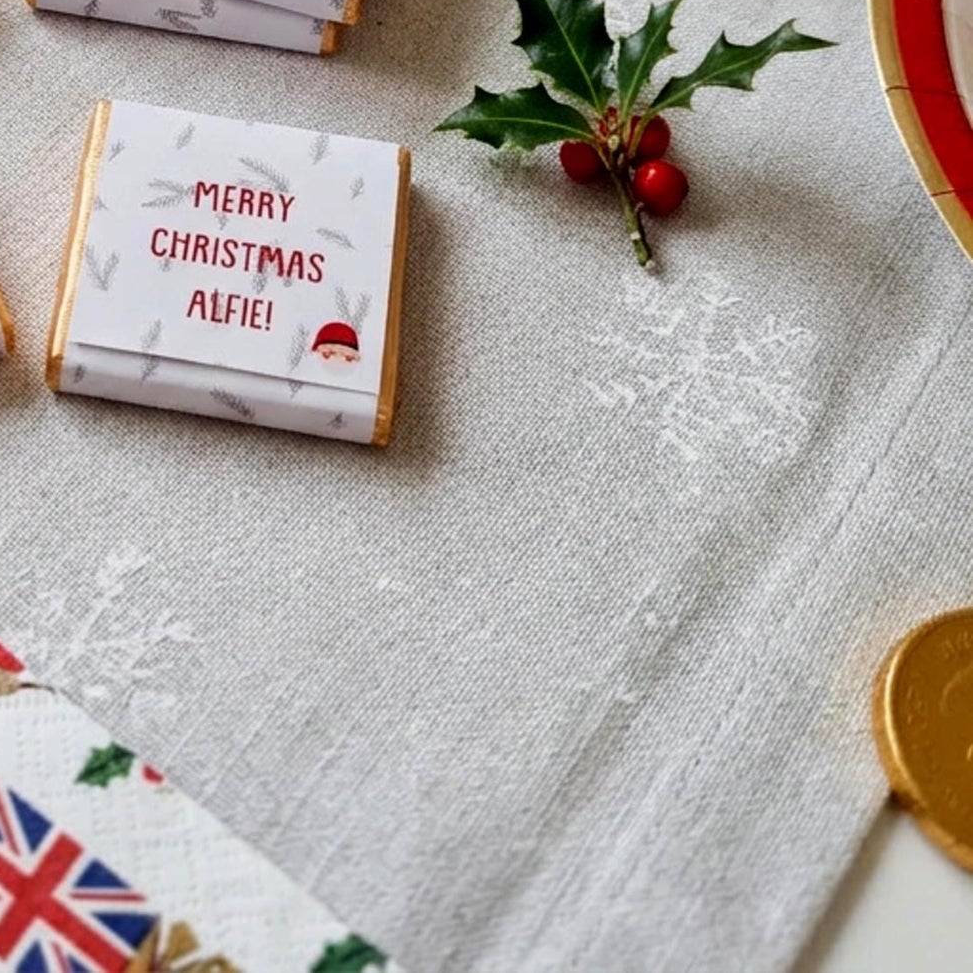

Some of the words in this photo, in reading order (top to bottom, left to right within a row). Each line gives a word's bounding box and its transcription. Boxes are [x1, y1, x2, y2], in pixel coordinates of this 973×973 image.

[194, 181, 294, 221] MERRY
[151, 228, 325, 283] CHRISTMAS
[187, 290, 273, 331] ALFIE!
